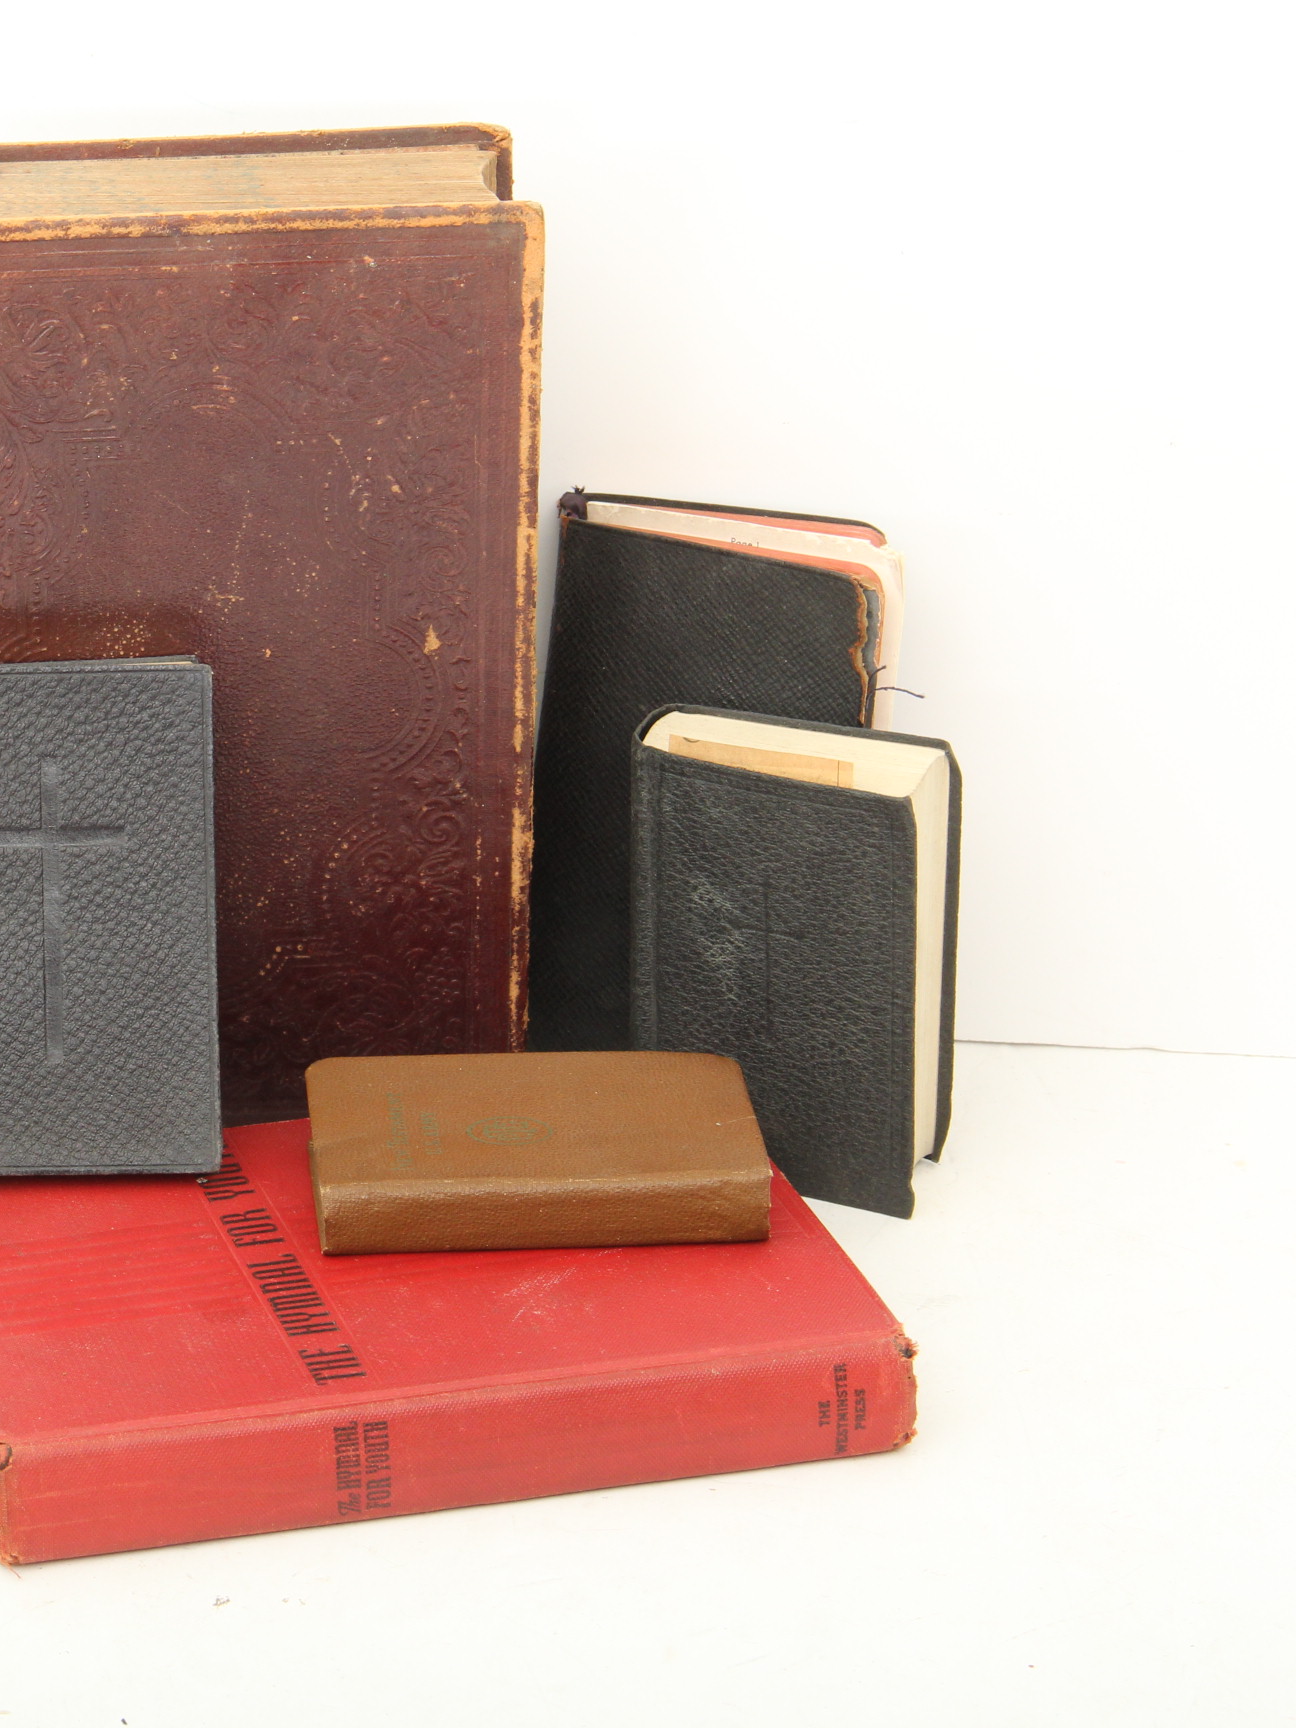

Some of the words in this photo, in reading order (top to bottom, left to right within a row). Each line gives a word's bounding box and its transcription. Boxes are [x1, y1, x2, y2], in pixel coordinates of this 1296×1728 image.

[219, 1207, 285, 1248] FOR
[246, 1252, 340, 1337] HYMNAL
[298, 1343, 367, 1386] THE
[818, 1400, 831, 1428] THE
[833, 1362, 849, 1456] WESTMINSTER
[854, 1388, 866, 1431] PRESS
[333, 1420, 362, 1491] HYMNAL
[363, 1420, 391, 1475] YOUTH
[337, 1492, 362, 1516] The
[366, 1476, 392, 1510] FOR
